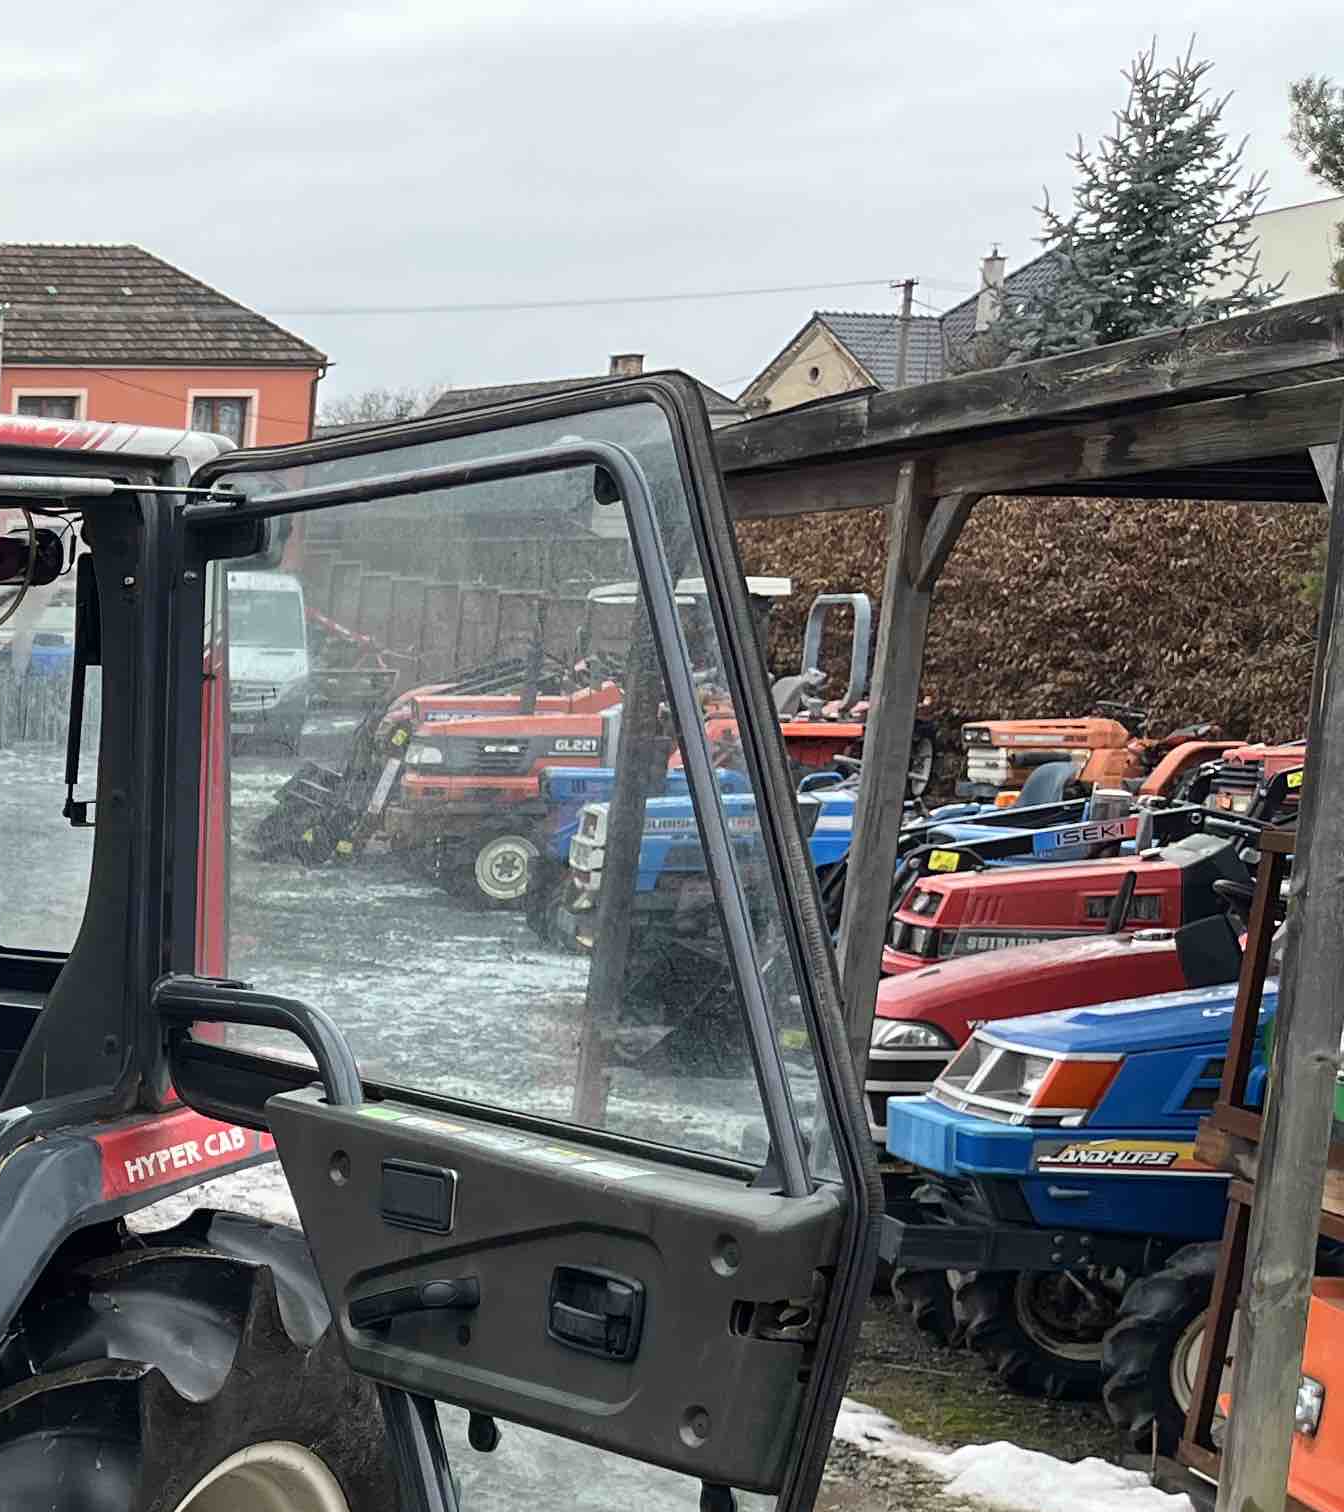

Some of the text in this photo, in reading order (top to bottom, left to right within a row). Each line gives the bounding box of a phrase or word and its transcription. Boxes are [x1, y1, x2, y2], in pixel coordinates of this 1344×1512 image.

[1055, 822, 1125, 847] ISEKI
[123, 1126, 246, 1184] HYPER CAB
